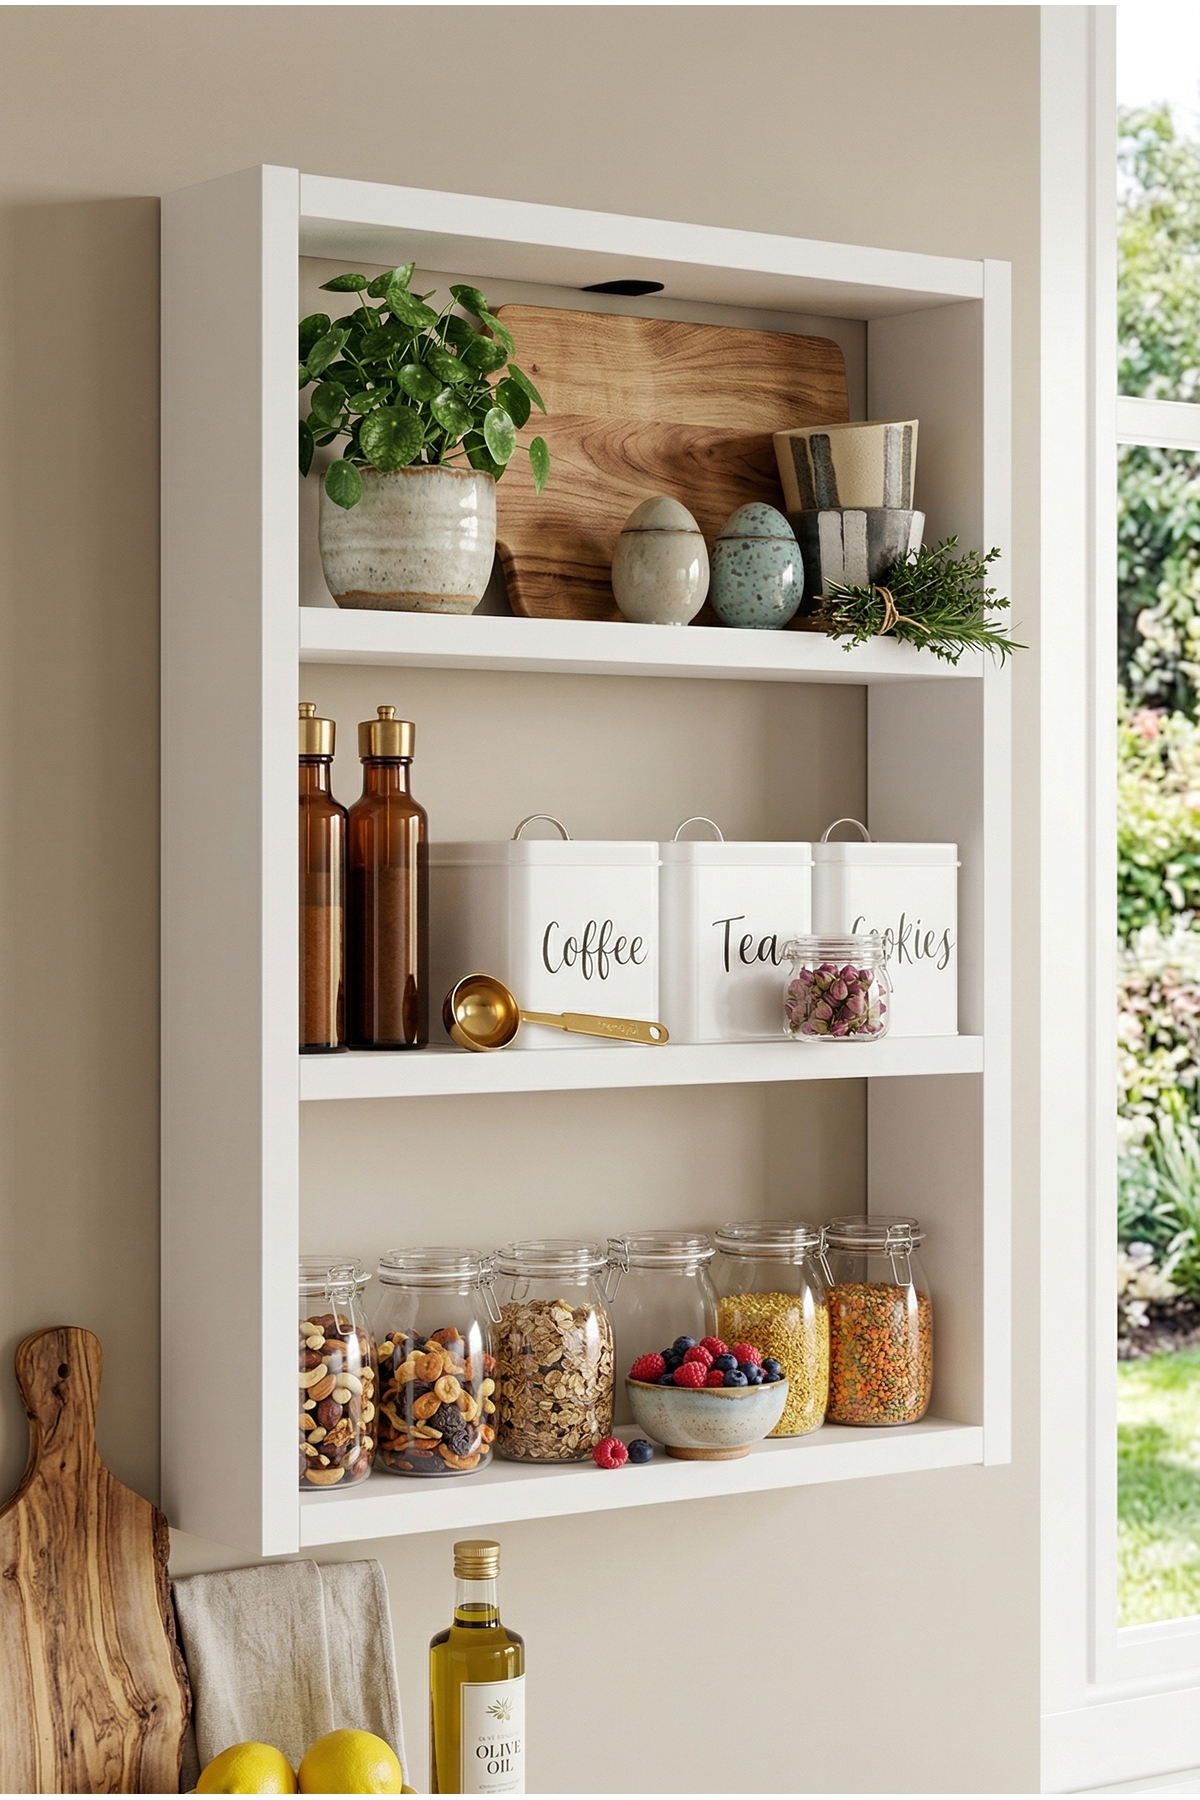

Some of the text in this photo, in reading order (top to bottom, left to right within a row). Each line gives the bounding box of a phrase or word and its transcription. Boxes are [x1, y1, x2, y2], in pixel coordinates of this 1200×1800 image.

[542, 919, 648, 981] Coffee
[712, 915, 783, 973] Tea
[476, 1739, 521, 1760] OLIVE
[486, 1758, 514, 1775] OIL
